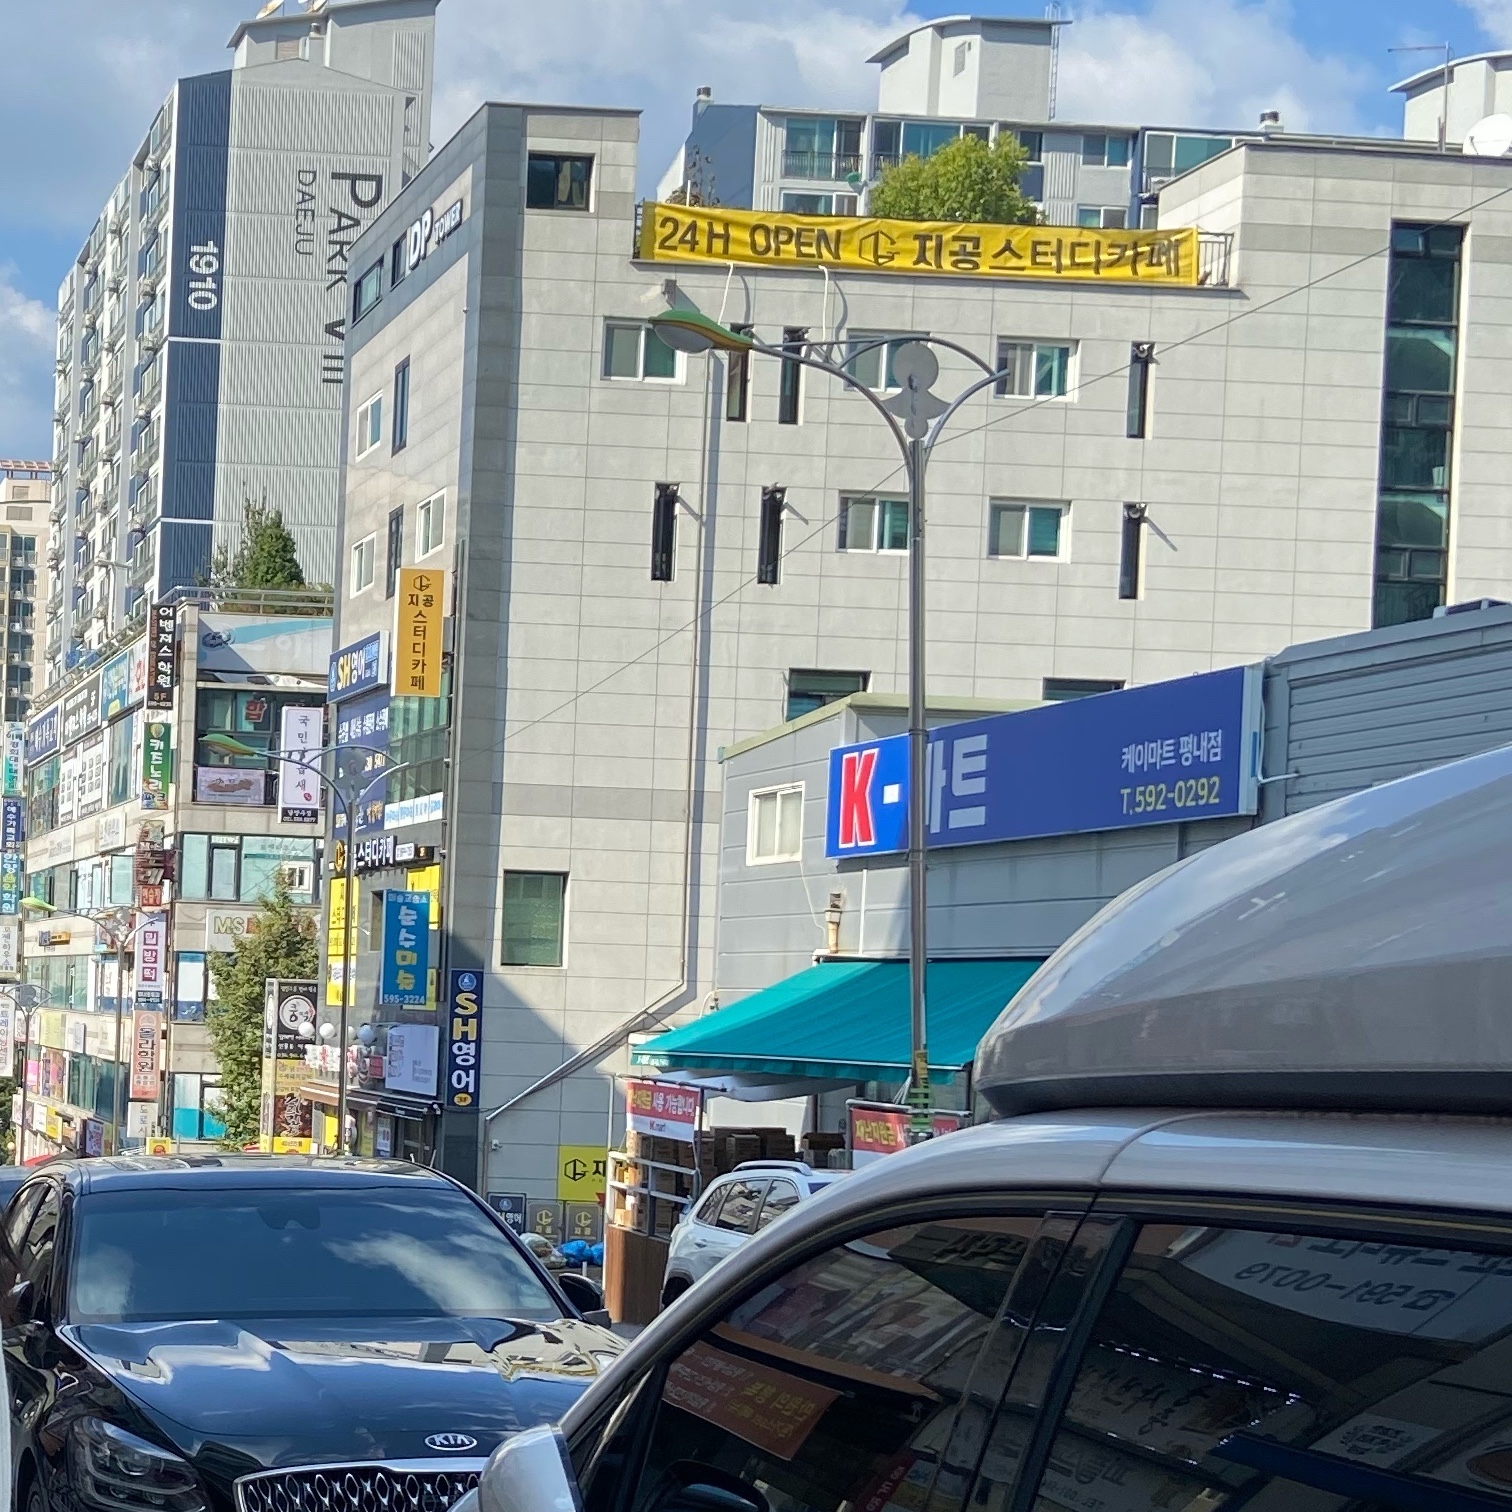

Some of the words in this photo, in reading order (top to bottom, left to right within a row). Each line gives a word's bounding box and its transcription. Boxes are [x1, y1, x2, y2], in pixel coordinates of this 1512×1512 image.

[295, 169, 317, 257] DAEJU
[434, 199, 463, 245] TOWER
[749, 223, 842, 261] OPEN
[188, 240, 219, 310] 1910
[407, 593, 435, 608] 지공
[157, 607, 174, 657] 어벤져스
[410, 609, 428, 691] 스터디카페
[157, 661, 173, 688] 학원
[1120, 738, 1176, 775] 케이마트
[1179, 728, 1224, 768] 평내점
[838, 733, 988, 848] K-트
[1119, 775, 1221, 815] T.592-0292
[451, 993, 479, 1093] SH영어
[430, 1433, 473, 1448] KIA
